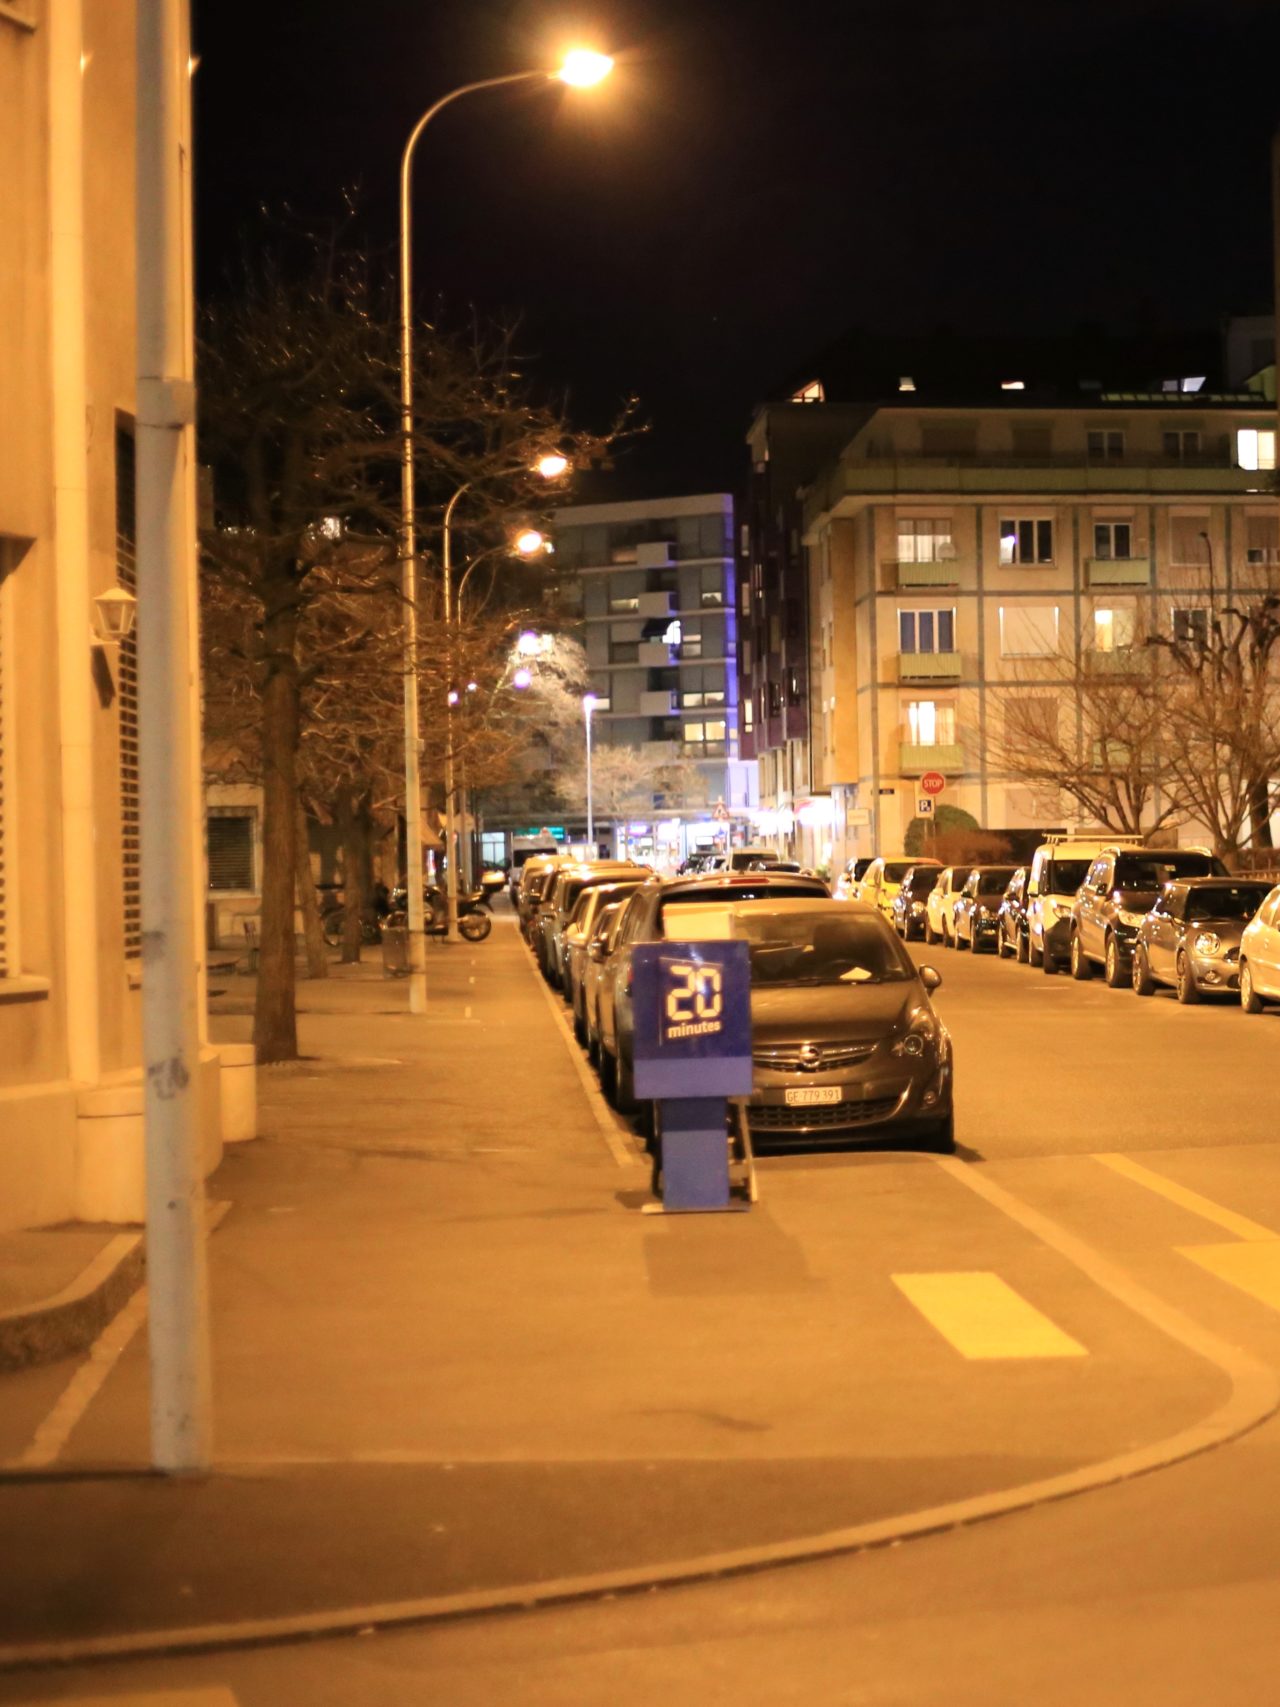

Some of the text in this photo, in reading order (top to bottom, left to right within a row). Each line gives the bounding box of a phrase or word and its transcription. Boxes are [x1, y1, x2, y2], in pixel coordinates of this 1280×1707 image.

[924, 779, 942, 788] STOP
[667, 965, 721, 1020] 20
[667, 1021, 721, 1038] minutes
[786, 1091, 799, 1102] GE
